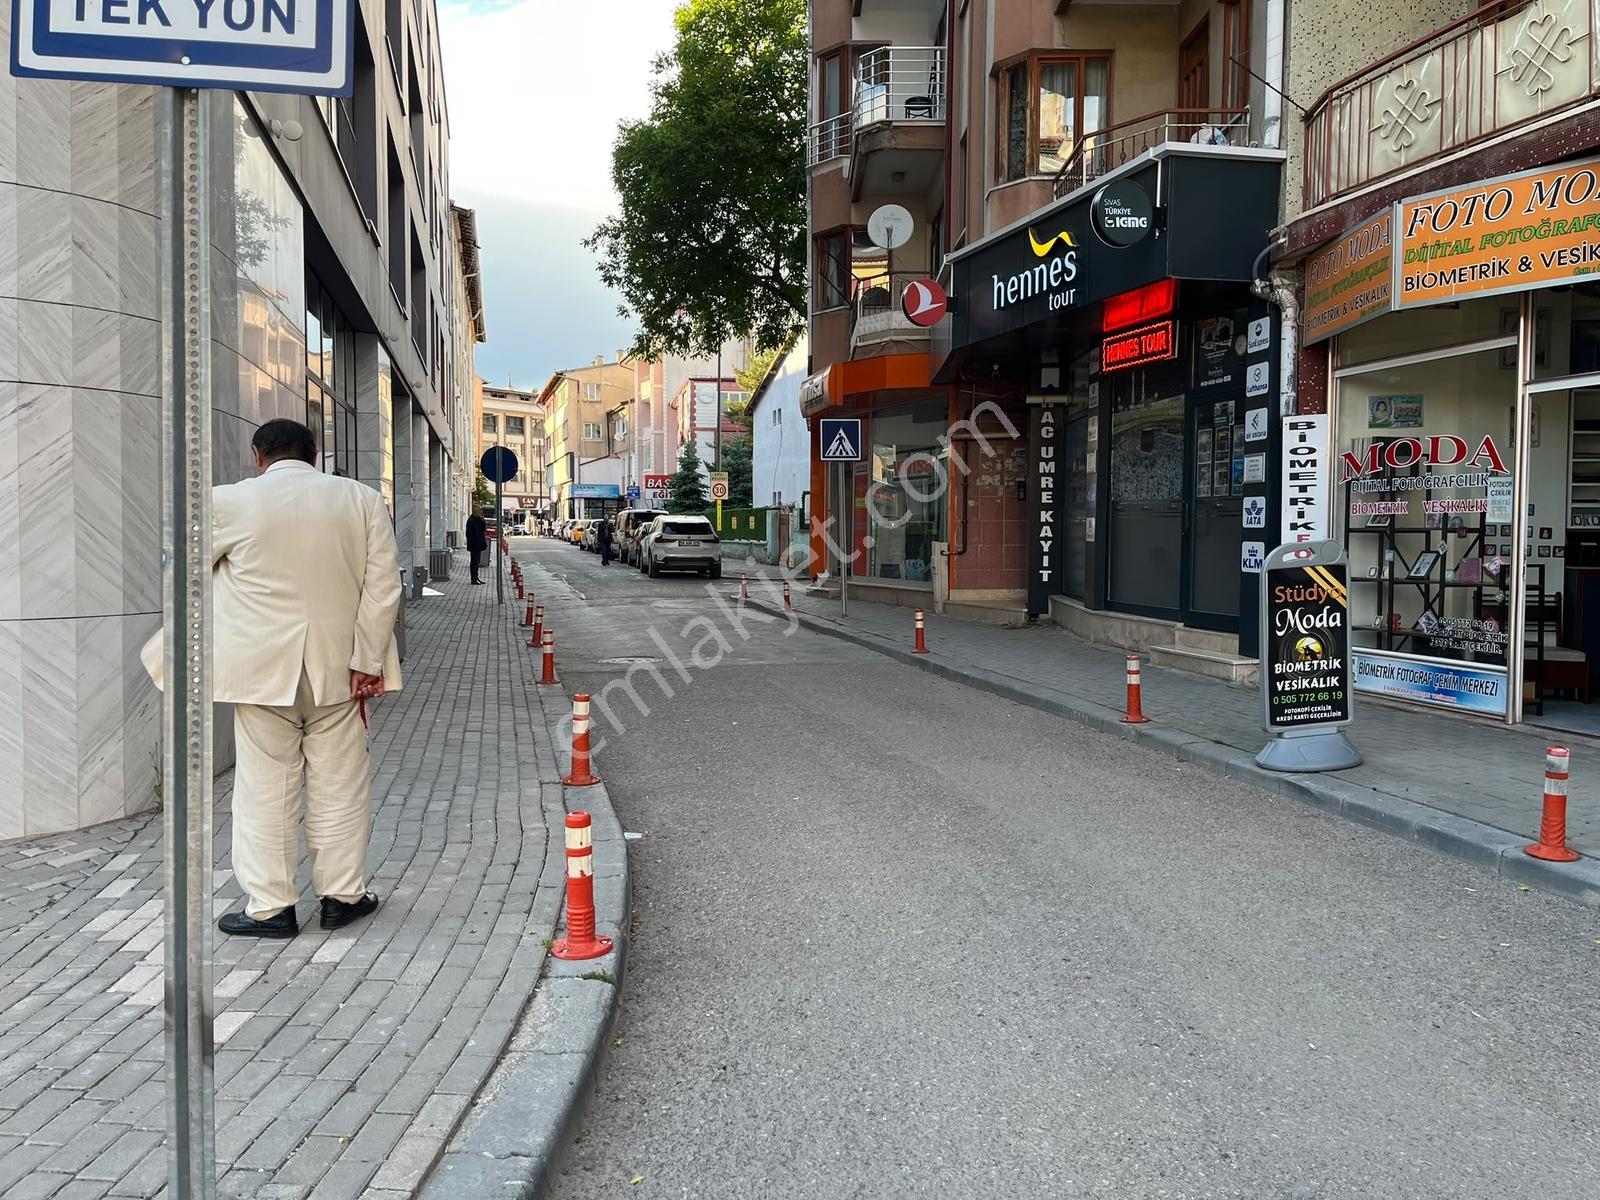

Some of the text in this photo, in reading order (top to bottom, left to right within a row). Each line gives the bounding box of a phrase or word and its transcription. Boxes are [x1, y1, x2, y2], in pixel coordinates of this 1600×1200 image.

[1104, 206, 1132, 215] TÜRKİYE
[1404, 187, 1514, 239] FOTO
[1115, 216, 1148, 228] IGMG
[1307, 245, 1344, 289] FOTO
[1344, 216, 1391, 269] MODA
[1403, 237, 1475, 265] DİJİTAL
[991, 250, 1078, 311] hennes
[1404, 257, 1512, 292] BİOMETRİK
[1517, 255, 1533, 273] &
[1048, 288, 1077, 311] tour
[1342, 302, 1348, 316] &
[1350, 282, 1390, 312] VESİKALIK
[1106, 330, 1167, 363] HENNES TOUR
[1339, 434, 1511, 485] MODA
[1039, 446, 1055, 503] UMRE
[1352, 476, 1390, 493] DİJİTAL
[715, 486, 724, 494] 30
[1351, 498, 1408, 515] BİOMETRİK
[1422, 496, 1488, 513] VESİKALIK
[1246, 516, 1261, 525] IATA
[1039, 510, 1053, 582] KAYIT
[1242, 558, 1263, 569] KLM
[1274, 583, 1341, 604] Stüdyo
[1275, 605, 1342, 637] Moda
[1457, 618, 1471, 629] 772
[1483, 620, 1494, 631] 19
[1274, 656, 1342, 675] BİOMETRİK
[1276, 676, 1340, 692] VESİKALIK
[1358, 660, 1396, 680] BİOMETRİK
[1433, 671, 1459, 691] ÇEKİM
[1459, 676, 1500, 697] MERKEZİ
[1273, 690, 1343, 705] 0 505 772 66 19
[1276, 714, 1293, 722] KREDİ
